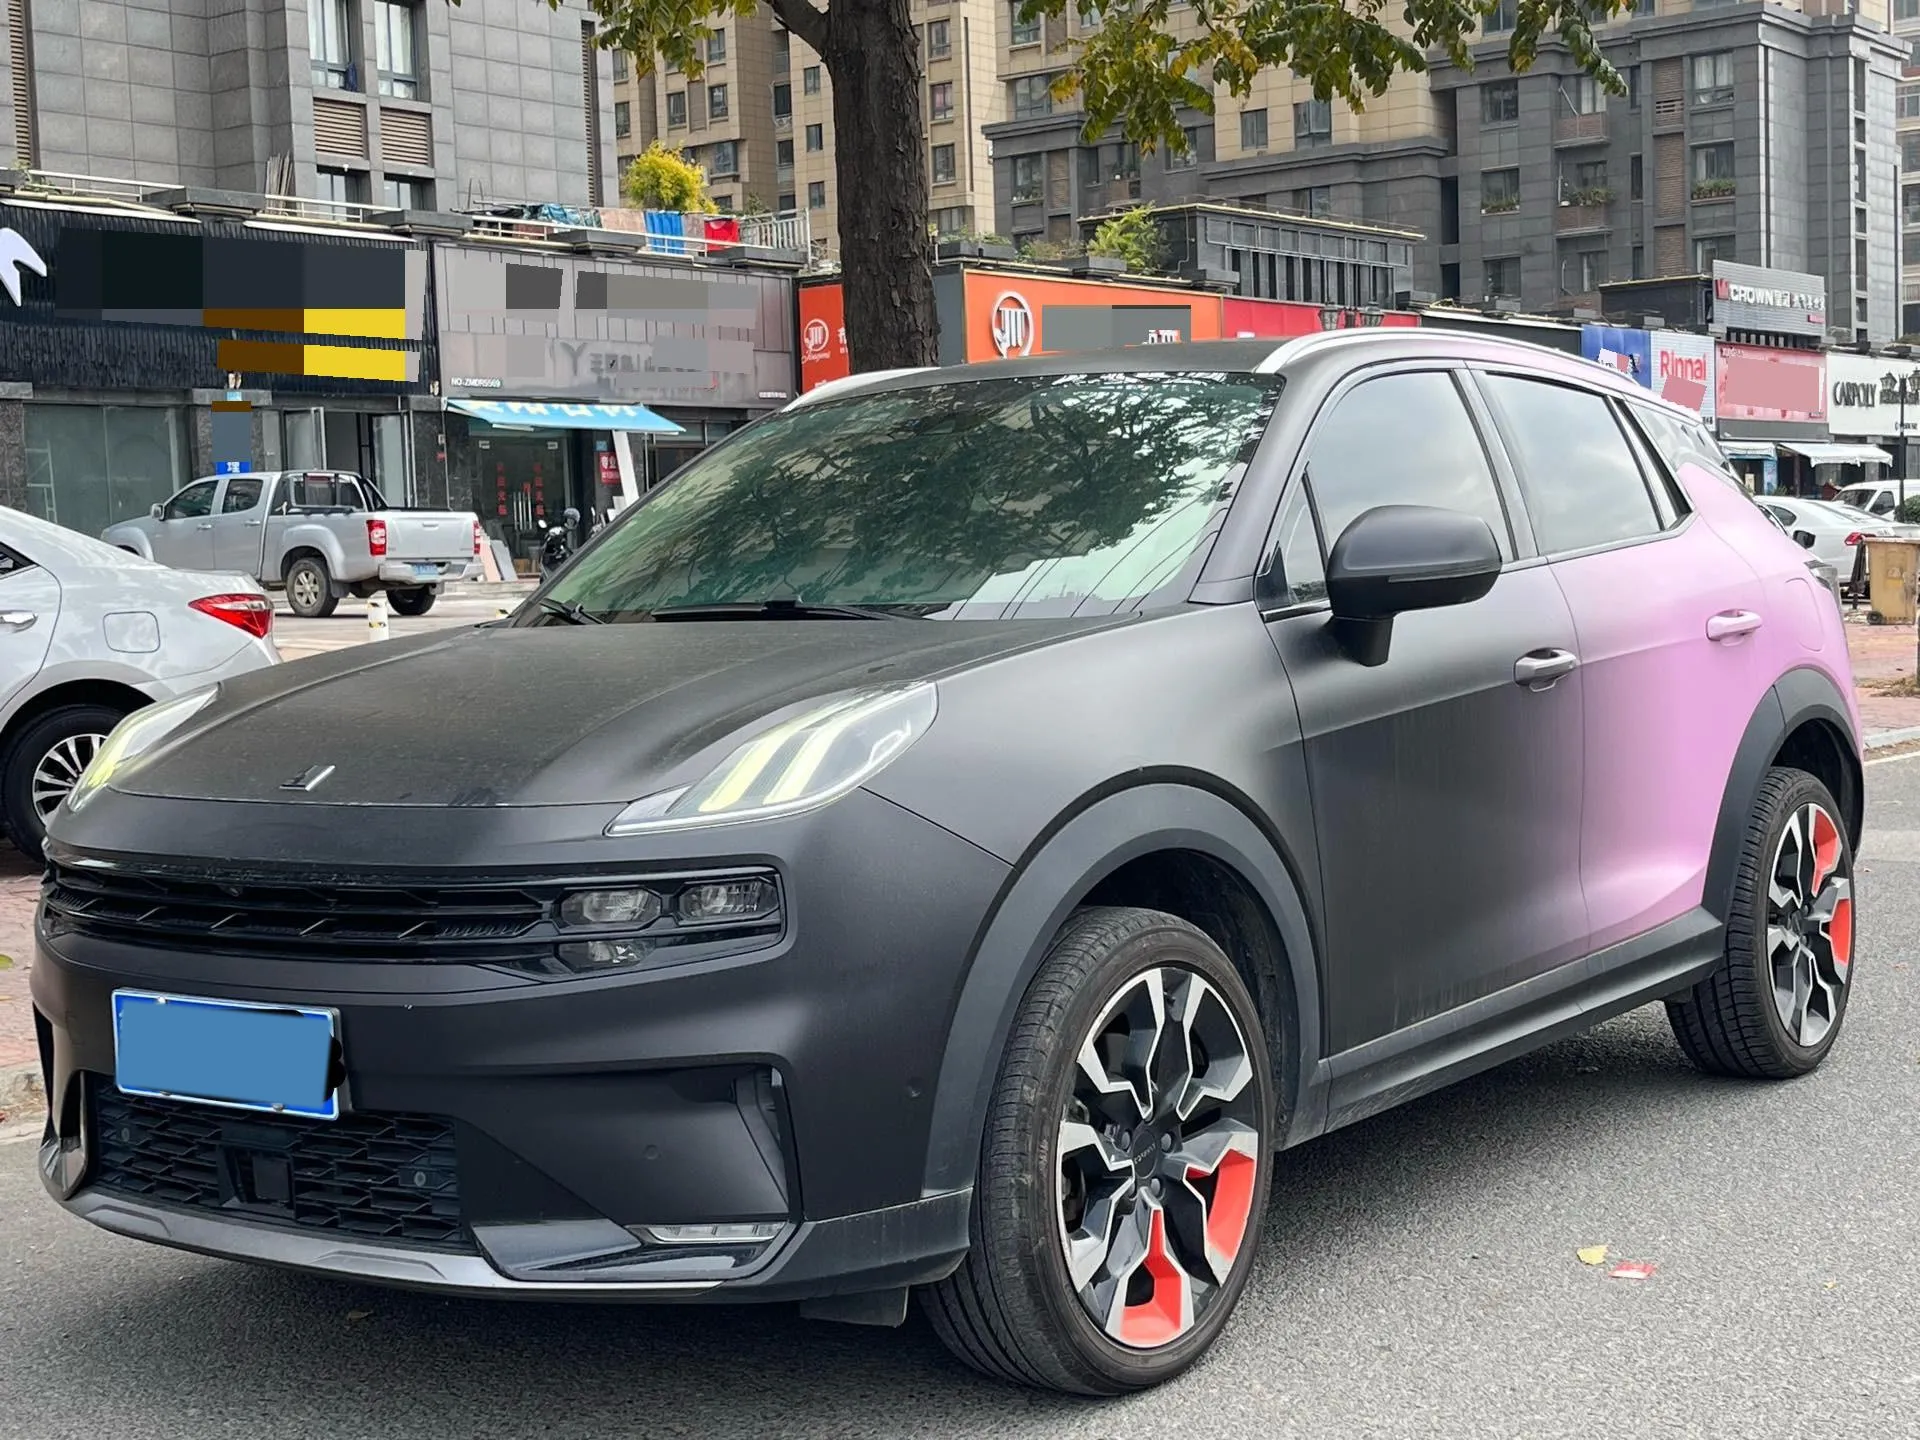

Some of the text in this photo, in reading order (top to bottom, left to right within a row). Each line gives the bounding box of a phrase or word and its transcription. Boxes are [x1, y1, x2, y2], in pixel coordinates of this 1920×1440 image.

[1729, 283, 1774, 306] CROWN
[1660, 350, 1707, 381] Rinnai
[1833, 381, 1877, 408] CARPOLY
